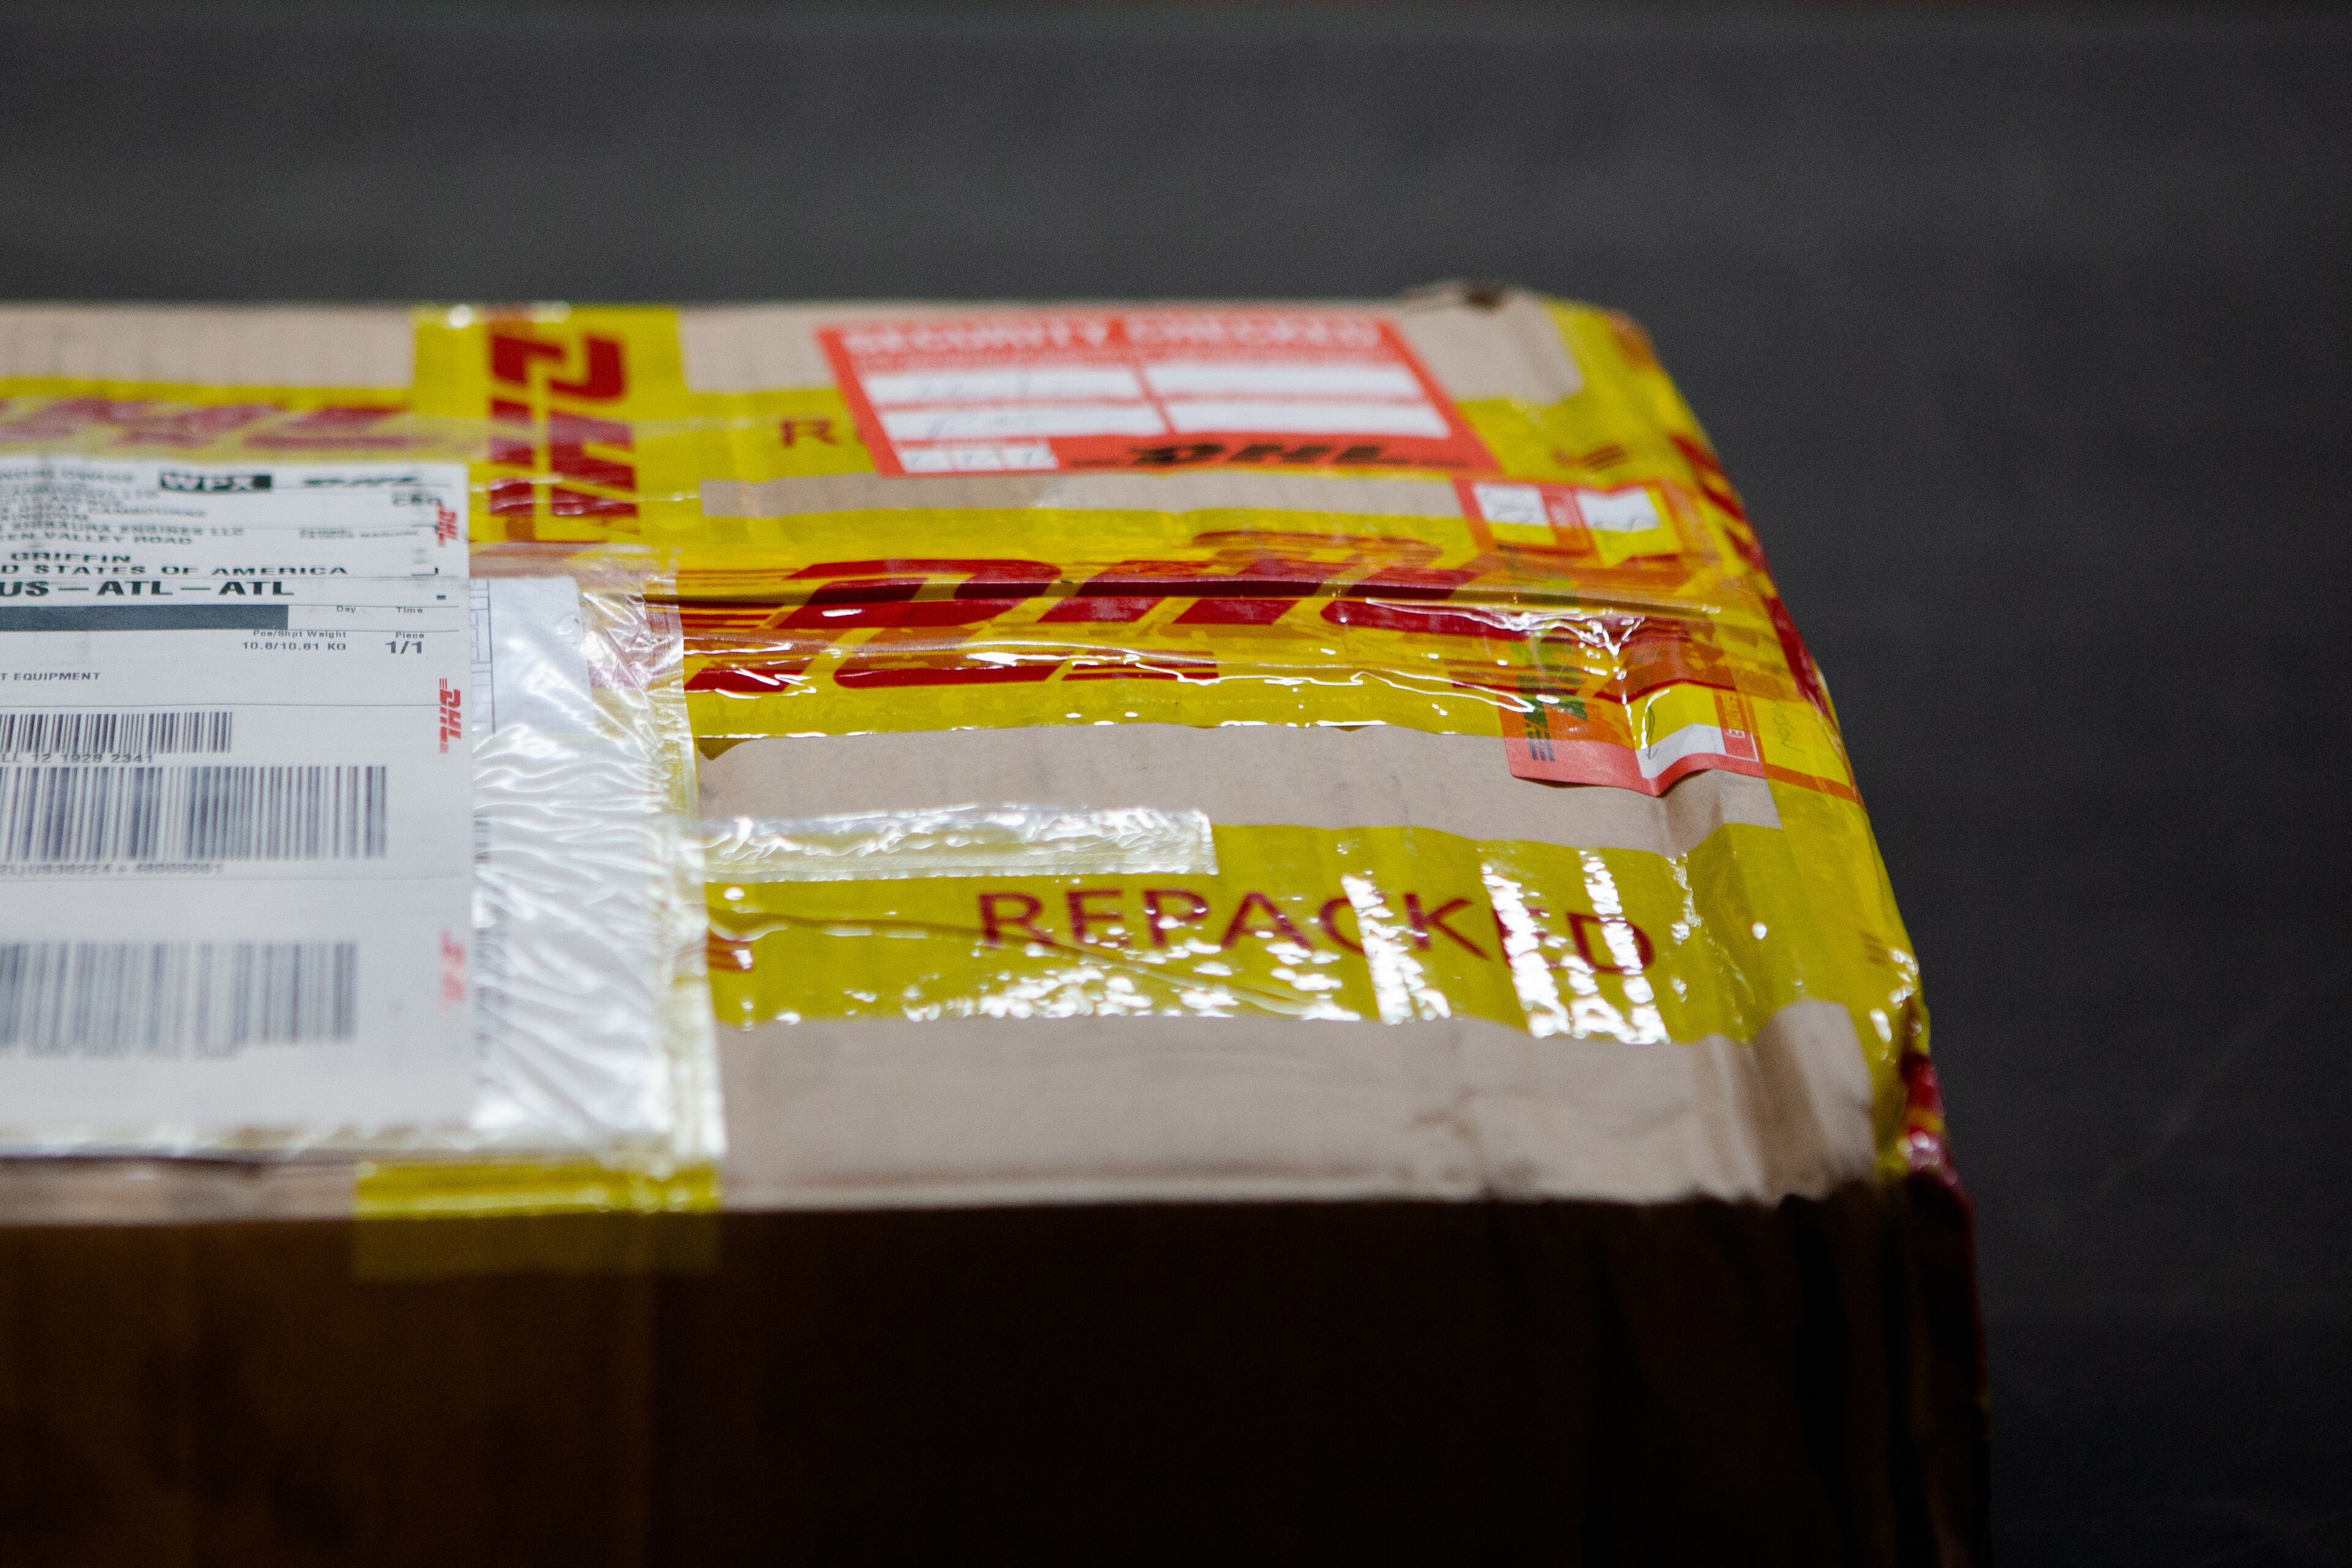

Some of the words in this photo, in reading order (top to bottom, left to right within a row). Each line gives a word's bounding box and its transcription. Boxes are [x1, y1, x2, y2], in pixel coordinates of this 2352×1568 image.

[1129, 443, 1410, 467] DHL
[162, 470, 254, 491] WPX
[44, 532, 124, 543] VALLEY
[134, 535, 193, 544] ROAD
[10, 552, 132, 564] GRIFFIN
[34, 565, 146, 576] STATES
[161, 566, 200, 576] OF
[211, 567, 348, 576] AMERICA
[306, 630, 347, 639] Weight
[327, 642, 347, 651] KG
[385, 640, 423, 654] 1/1
[13, 672, 101, 681] EQUIPMENT
[439, 687, 461, 744] DHL
[31, 753, 51, 763] 12
[110, 753, 153, 763] 2341
